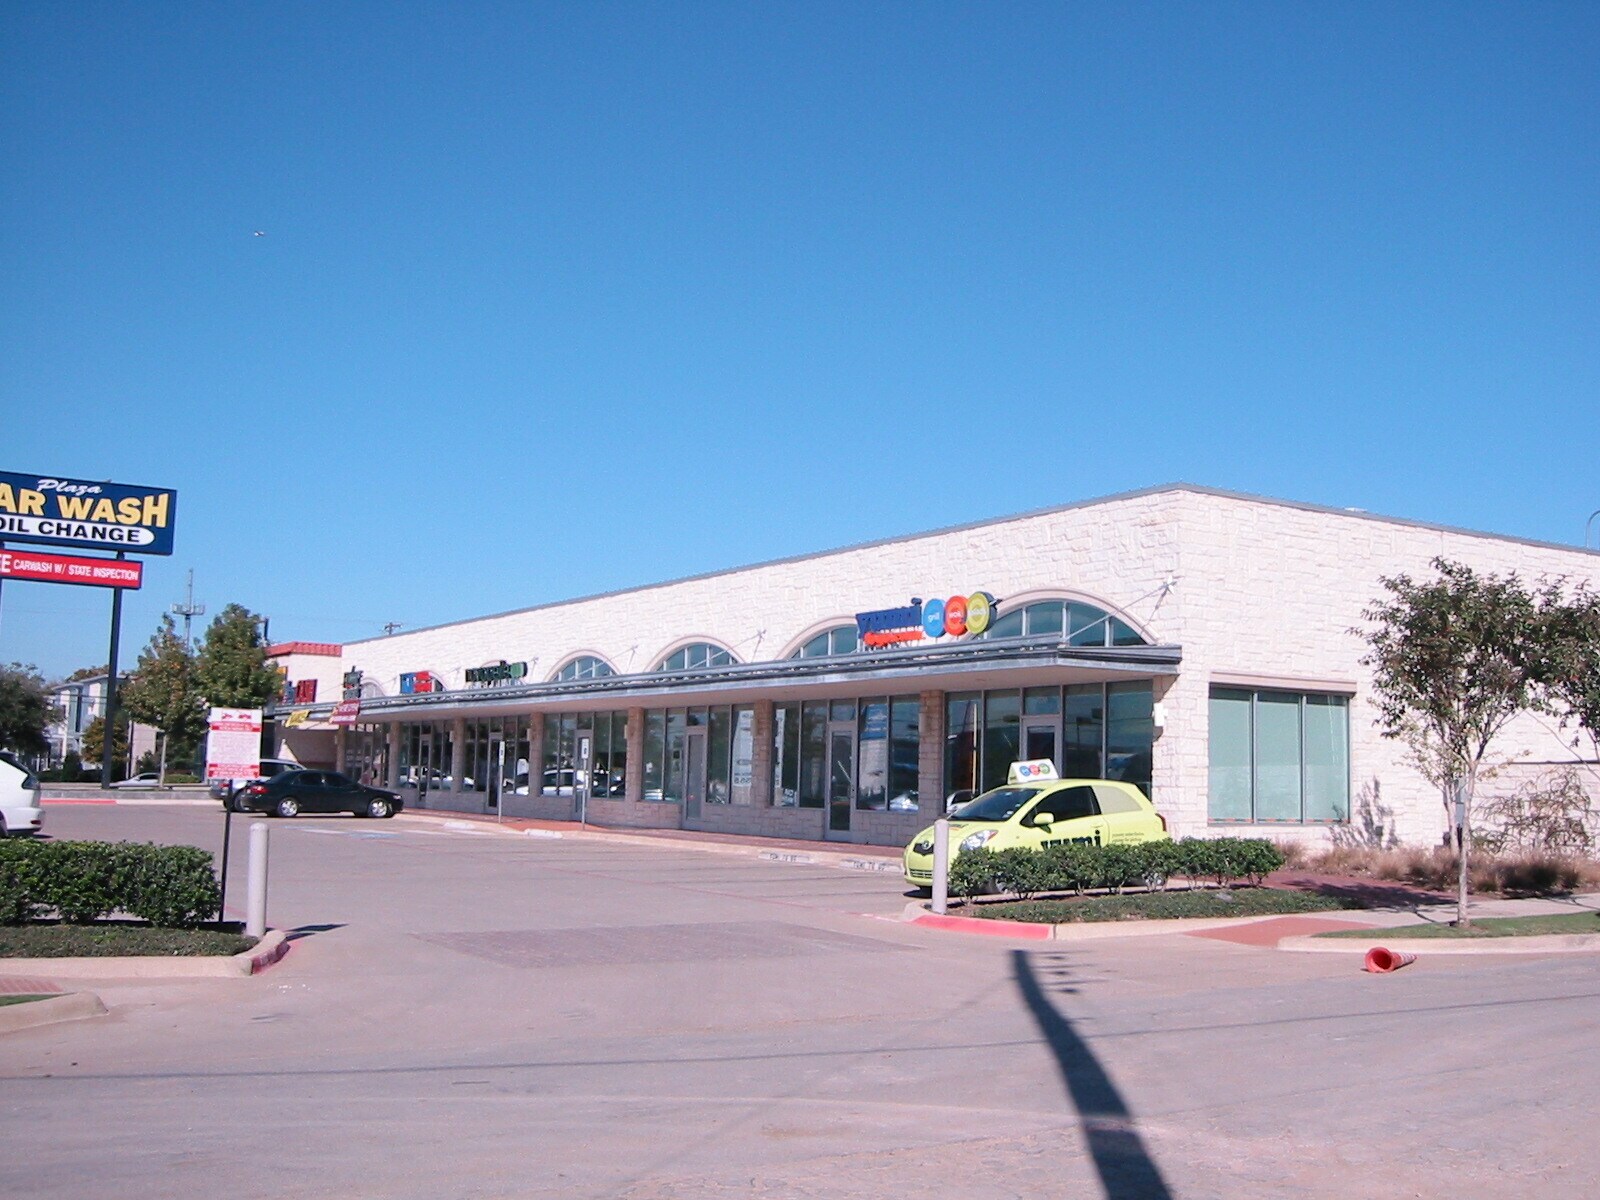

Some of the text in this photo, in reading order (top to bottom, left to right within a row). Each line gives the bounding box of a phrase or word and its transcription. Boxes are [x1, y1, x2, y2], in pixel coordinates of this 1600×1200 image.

[37, 479, 102, 496] Plaza
[57, 493, 169, 528] WASH
[38, 521, 141, 543] CHANGE
[13, 559, 52, 573] CARWASH
[54, 563, 66, 575] W/
[68, 564, 91, 577] STATE
[93, 568, 139, 581] INSPECTION
